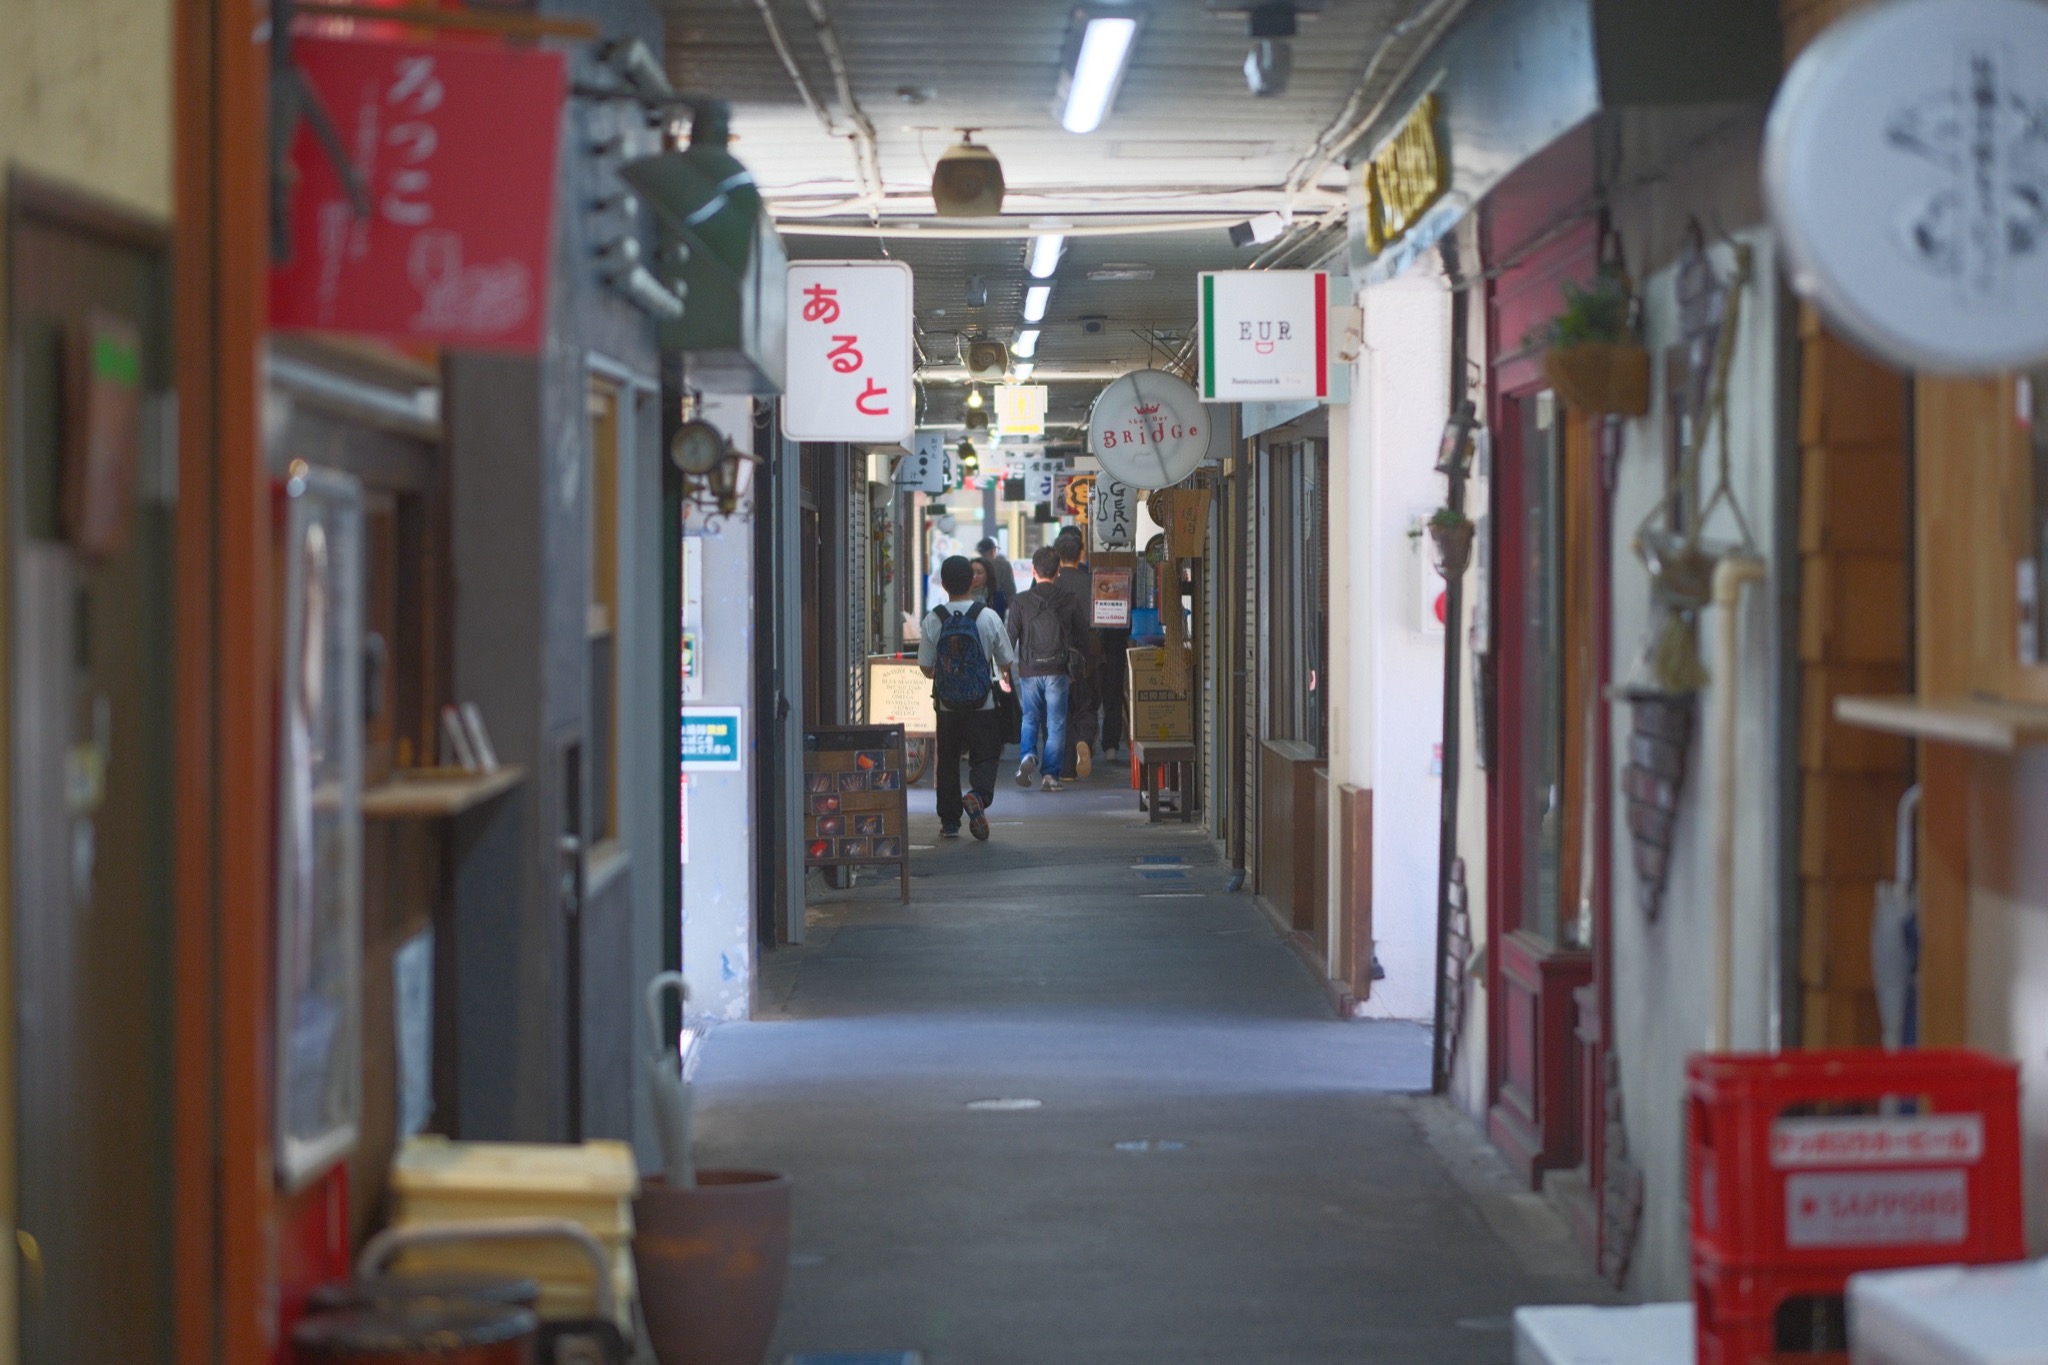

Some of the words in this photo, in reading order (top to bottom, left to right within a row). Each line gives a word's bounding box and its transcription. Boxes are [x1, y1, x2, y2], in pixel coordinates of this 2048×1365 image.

[1239, 321, 1293, 341] EUR
[803, 283, 889, 416] あると
[1829, 1188, 1960, 1218] SAPPORO
